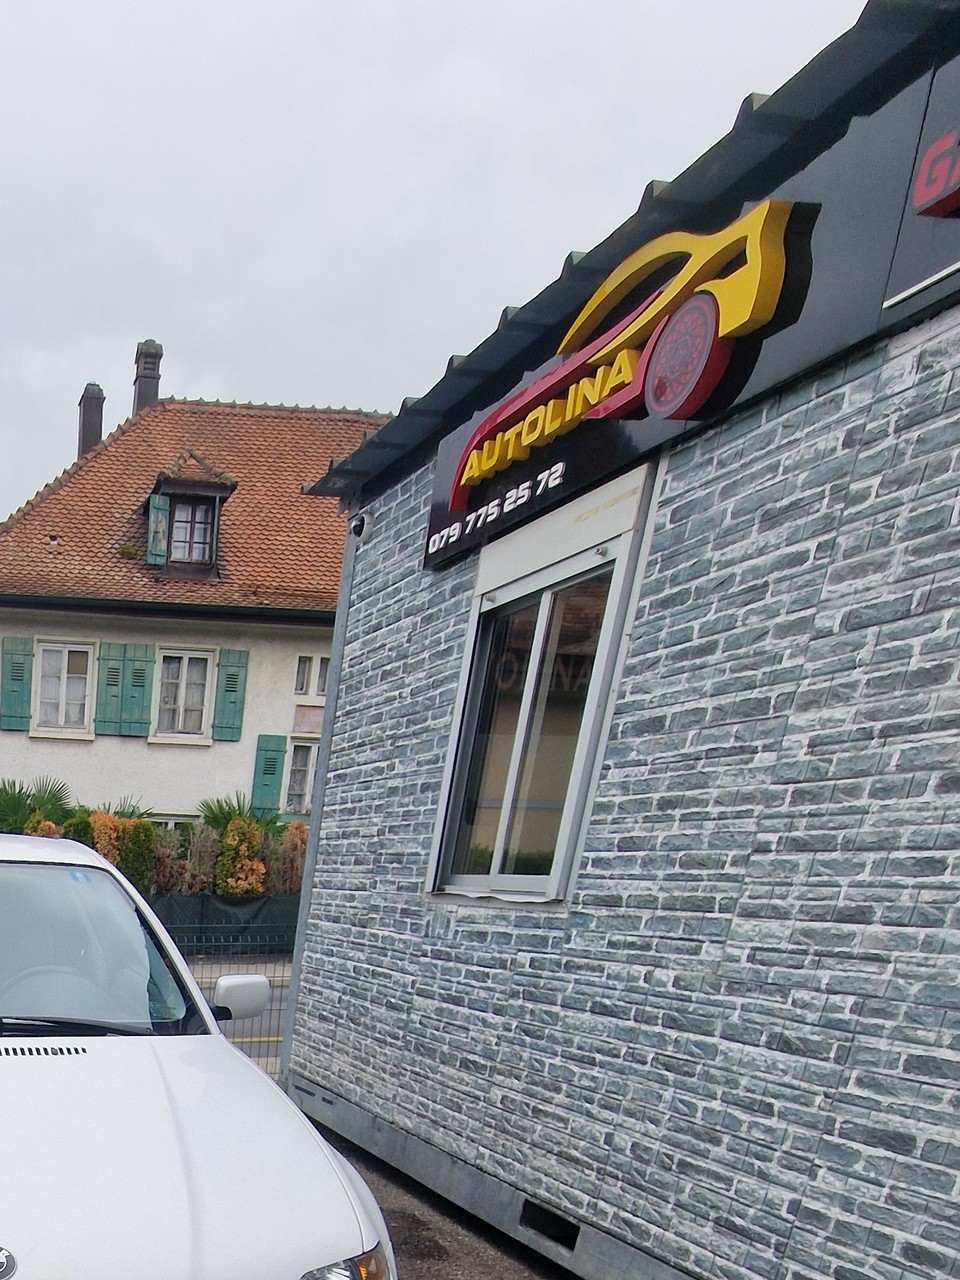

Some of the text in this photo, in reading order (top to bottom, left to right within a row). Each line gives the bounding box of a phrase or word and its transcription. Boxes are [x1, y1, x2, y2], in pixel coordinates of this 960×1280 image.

[913, 129, 960, 206] G
[460, 349, 635, 486] AUTOLINA
[428, 461, 566, 554] 079 775 25 72
